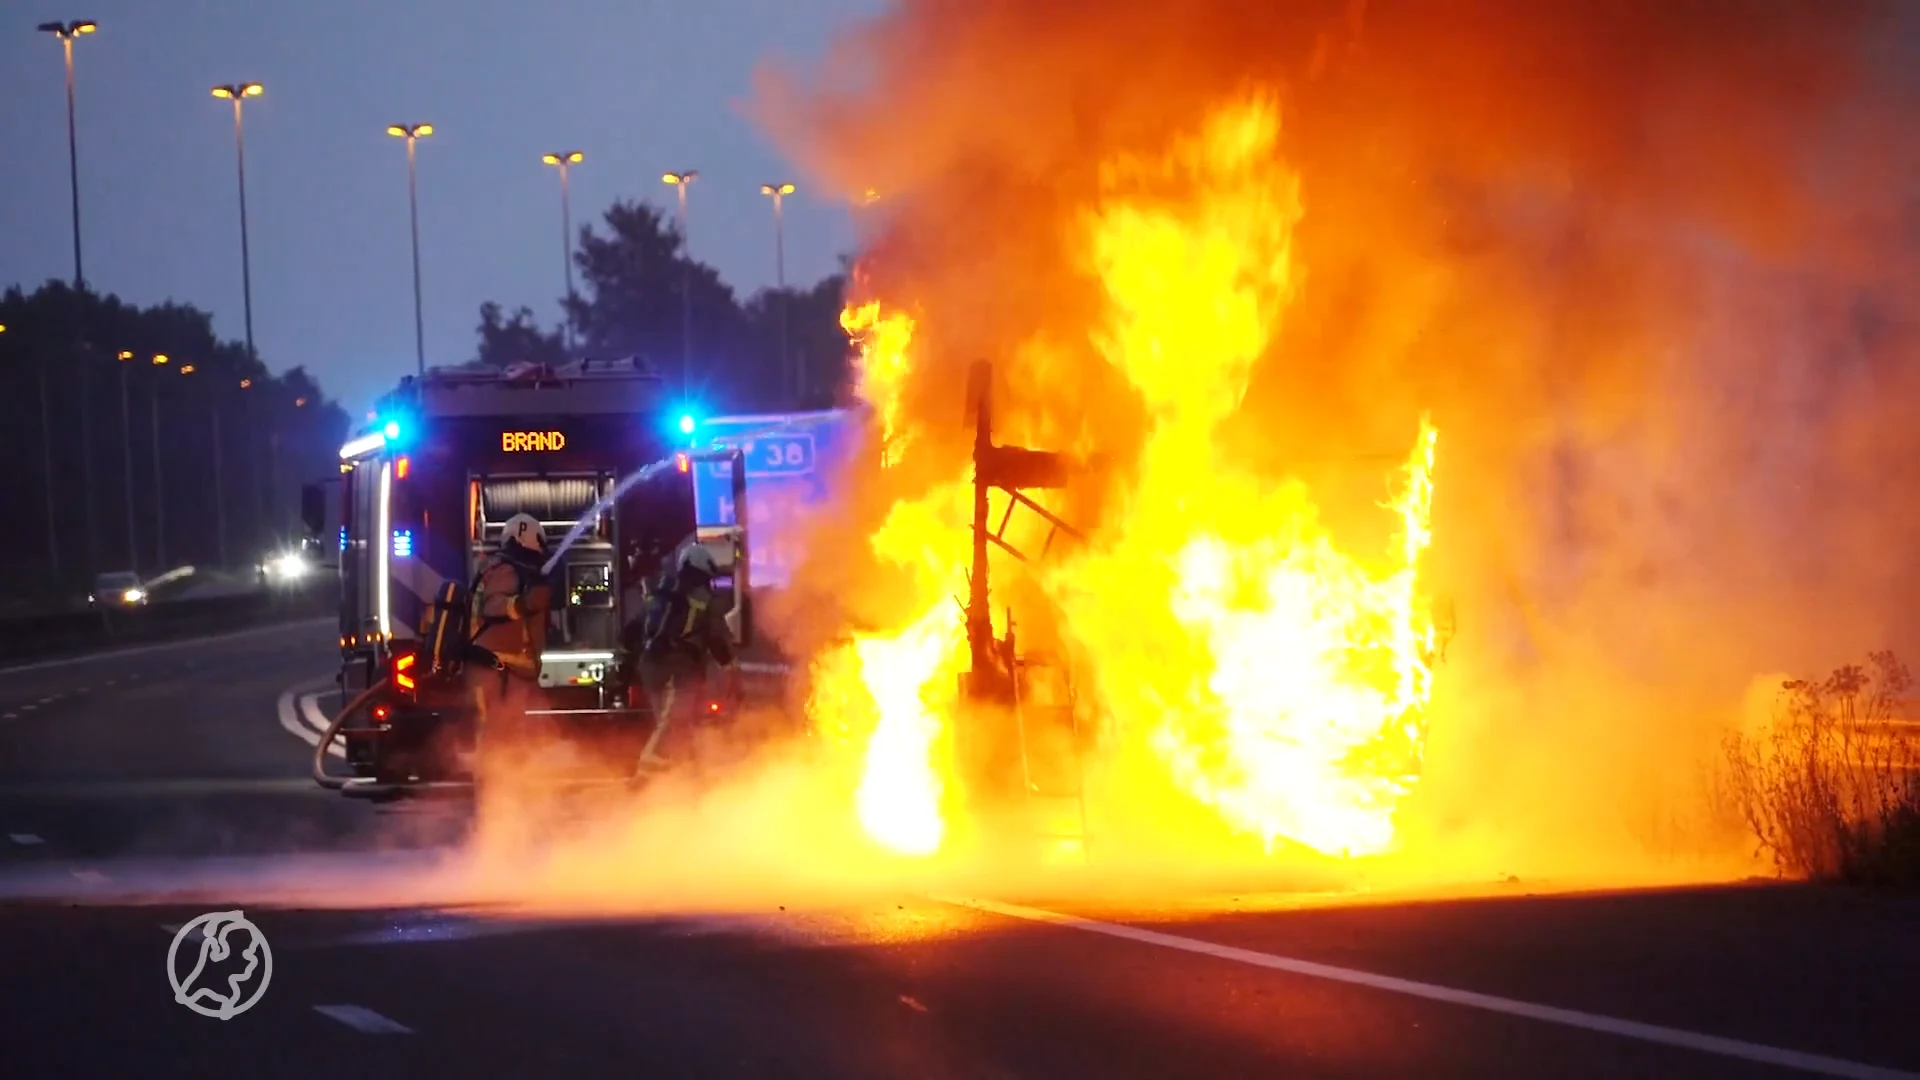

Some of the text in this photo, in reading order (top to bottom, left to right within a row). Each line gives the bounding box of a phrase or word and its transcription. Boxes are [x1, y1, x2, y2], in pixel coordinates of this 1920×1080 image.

[502, 431, 565, 451] BRAND
[765, 441, 804, 465] 38
[518, 521, 528, 537] P
